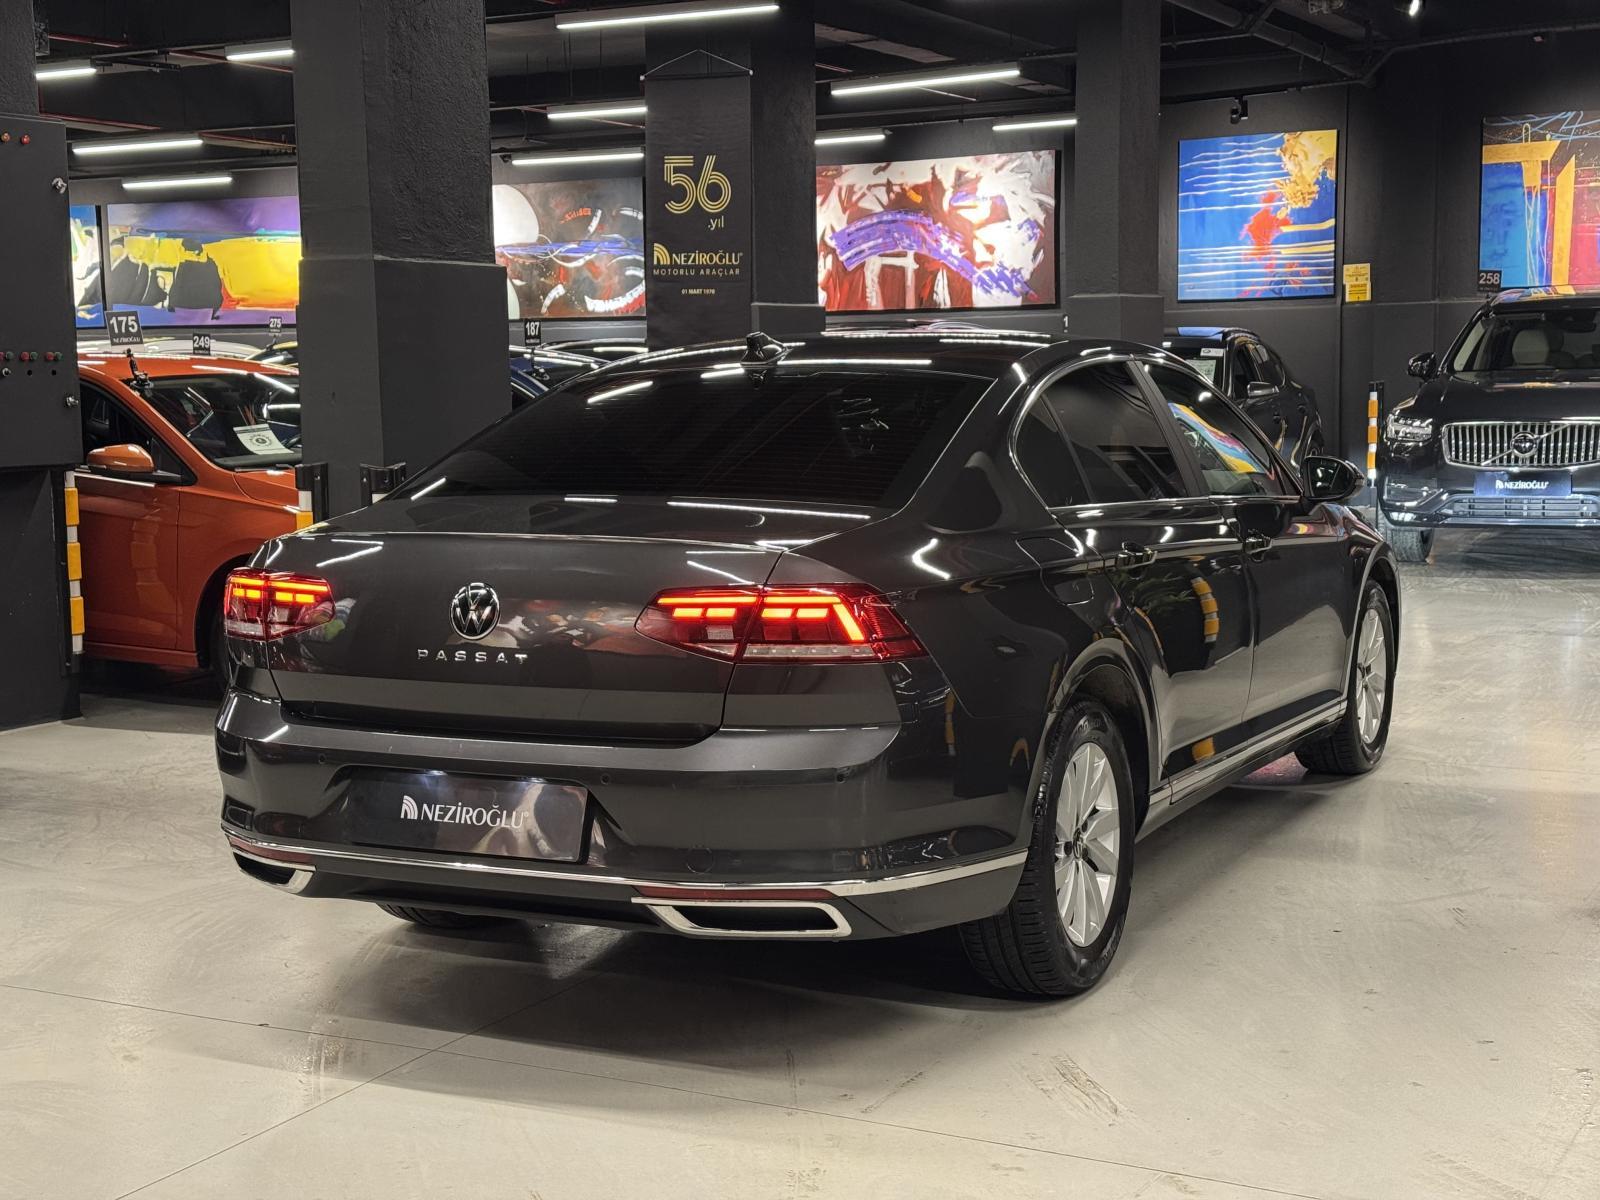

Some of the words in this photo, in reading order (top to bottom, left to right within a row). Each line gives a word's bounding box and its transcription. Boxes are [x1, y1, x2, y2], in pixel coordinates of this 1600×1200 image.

[664, 155, 732, 214] 56
[653, 268, 696, 276] MOTORLU
[699, 268, 740, 278] ARAÇLAR
[1479, 272, 1500, 285] 258
[110, 315, 138, 334] 175
[269, 318, 282, 328] 275
[525, 321, 540, 336] 187
[193, 335, 210, 348] 249
[416, 649, 528, 665] PASSAT
[420, 802, 524, 829] NEZİROĞLU
